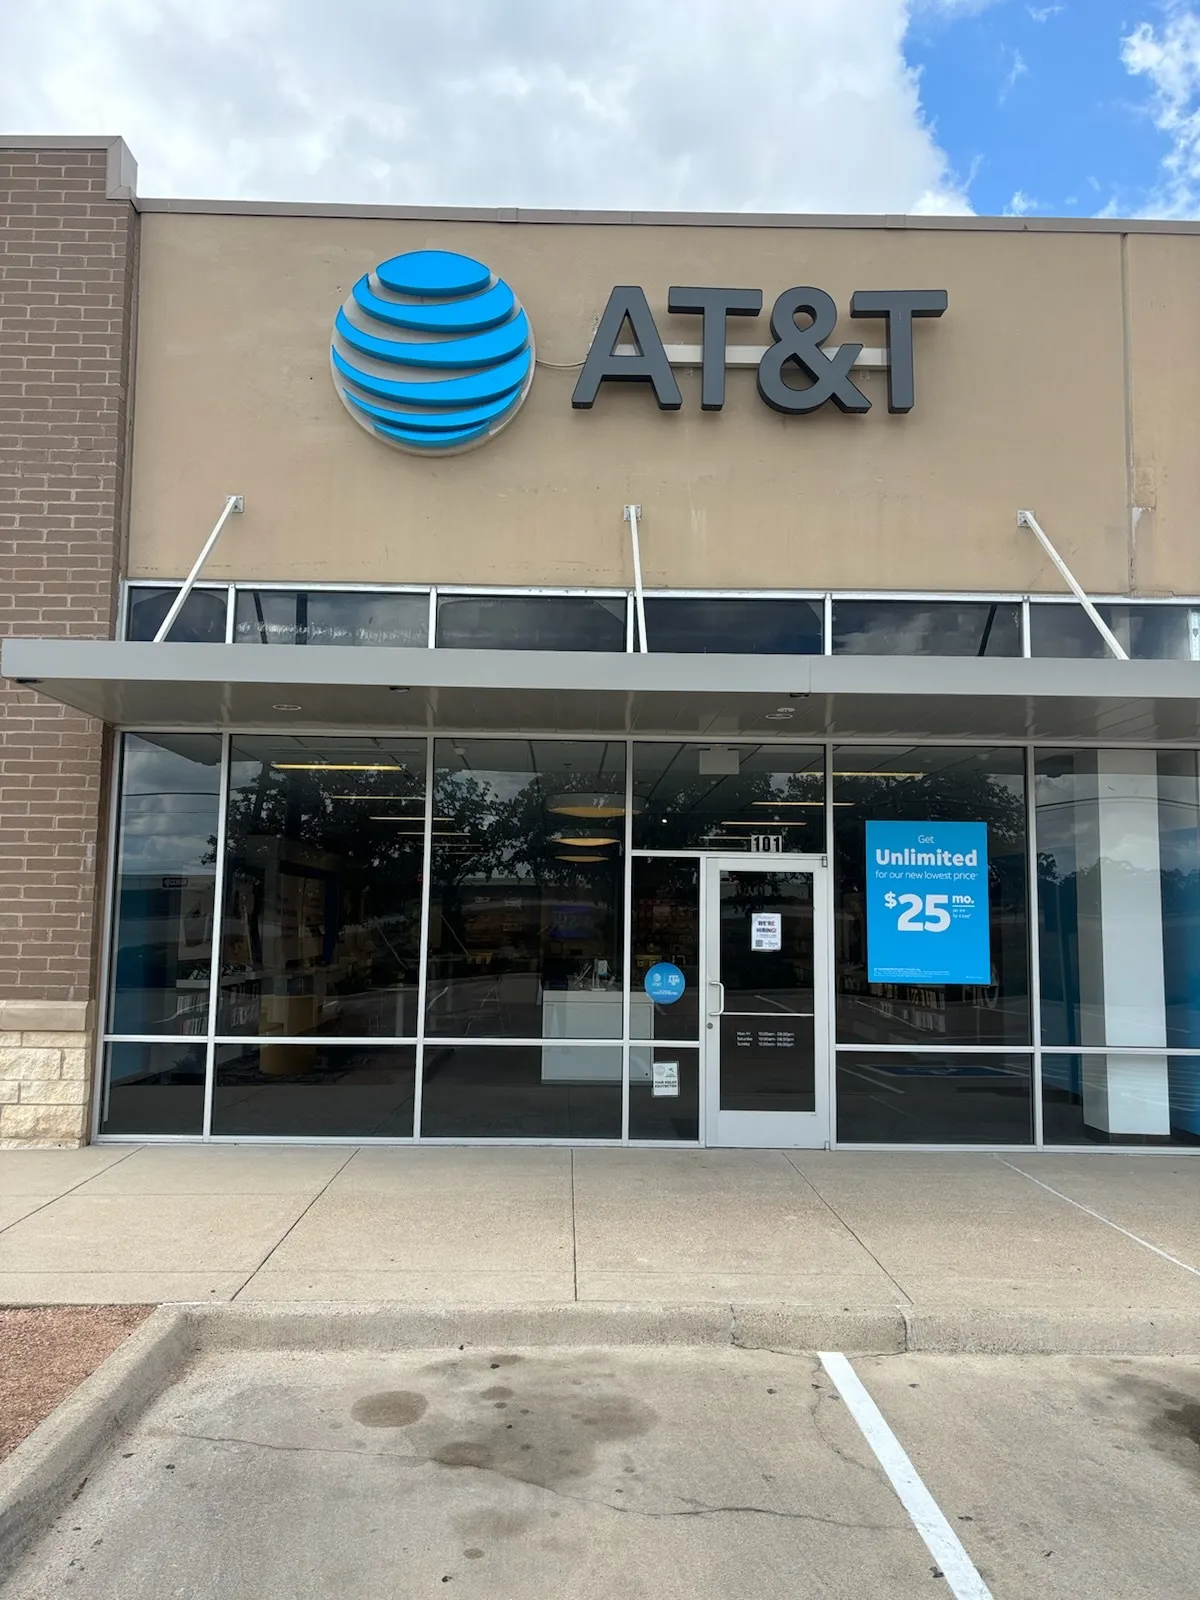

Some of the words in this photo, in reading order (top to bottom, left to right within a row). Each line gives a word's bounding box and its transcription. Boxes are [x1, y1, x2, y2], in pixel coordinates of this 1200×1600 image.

[571, 285, 949, 414] AT&T
[753, 836, 780, 851] 101
[918, 835, 934, 844] Get
[876, 848, 978, 867] Unlimited
[875, 870, 888, 879] for
[924, 871, 952, 880] lowest
[952, 895, 975, 904] mo.
